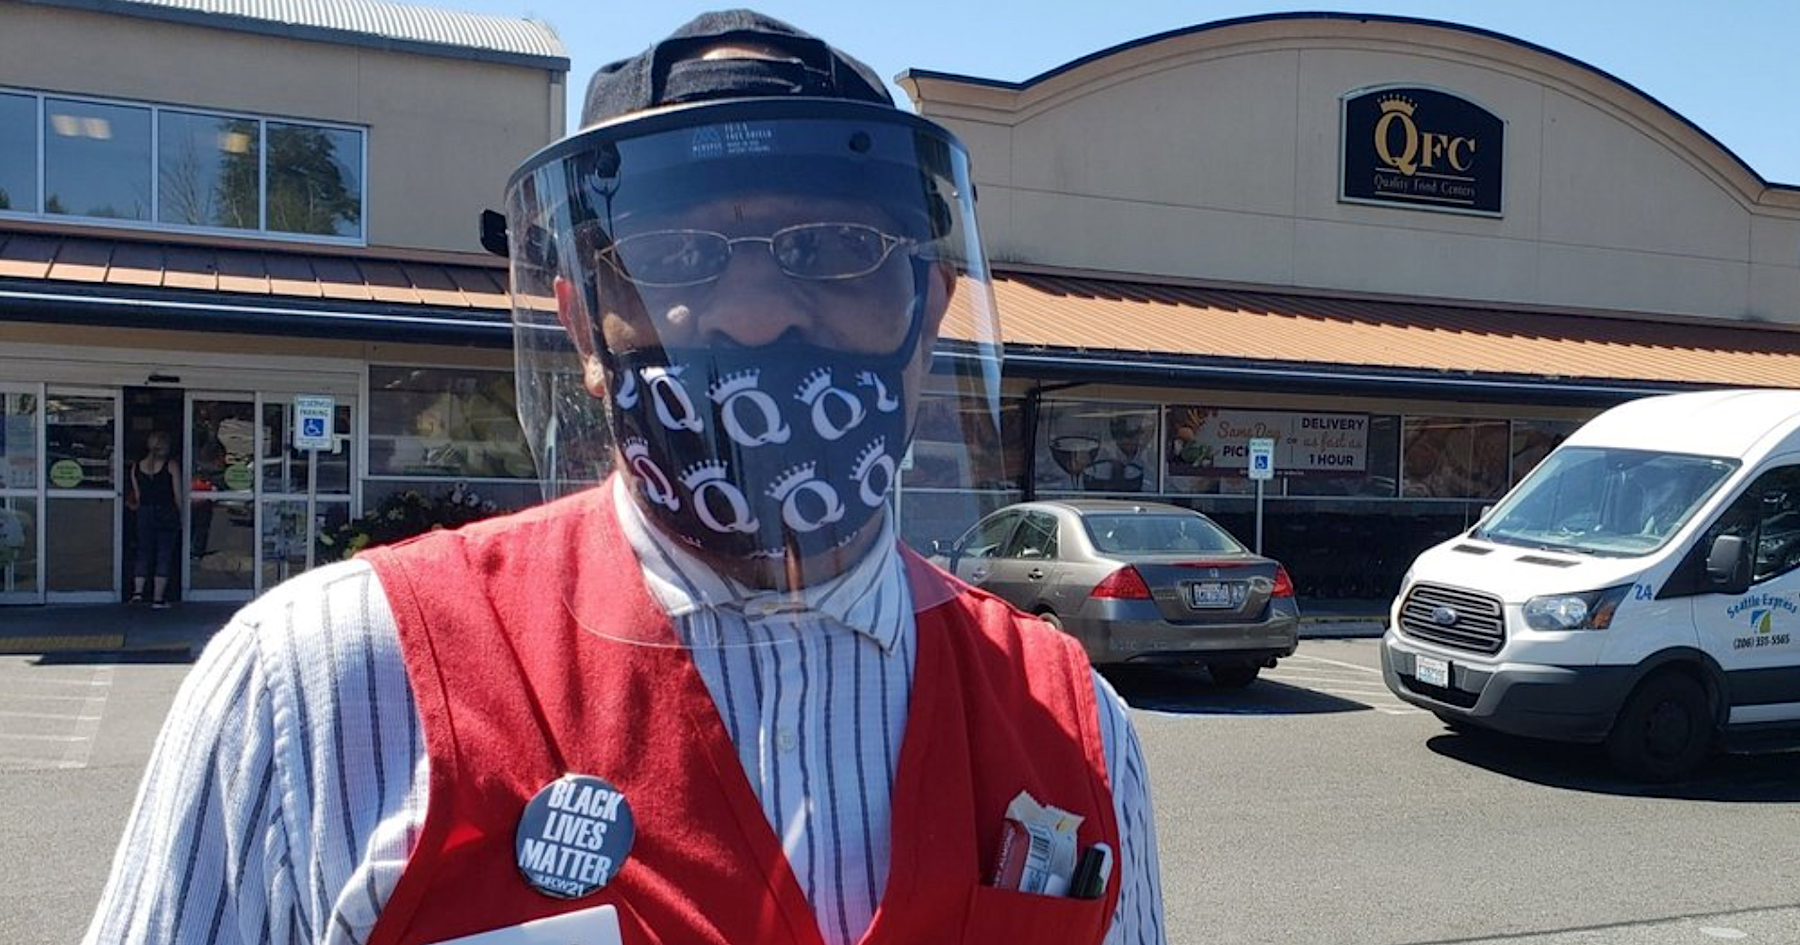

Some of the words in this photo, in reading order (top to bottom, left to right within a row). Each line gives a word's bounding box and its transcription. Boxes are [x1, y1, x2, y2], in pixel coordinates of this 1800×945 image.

[1375, 111, 1476, 176] QFC
[1374, 174, 1408, 192] Quality
[1414, 178, 1437, 192] Food
[1441, 180, 1476, 197] Centers
[721, 389, 791, 446] Q
[1301, 417, 1365, 431] DELIVERY
[1320, 431, 1347, 453] fast
[1309, 454, 1315, 465] 1
[1318, 454, 1354, 466] HOUR
[694, 479, 760, 532] Q
[782, 480, 845, 532] Q
[1634, 584, 1652, 600] 24
[1726, 594, 1760, 619] Seattle
[1762, 593, 1798, 614] Express
[548, 781, 625, 822] BLACK
[542, 811, 607, 851] LIVES
[518, 837, 612, 887] MATTER
